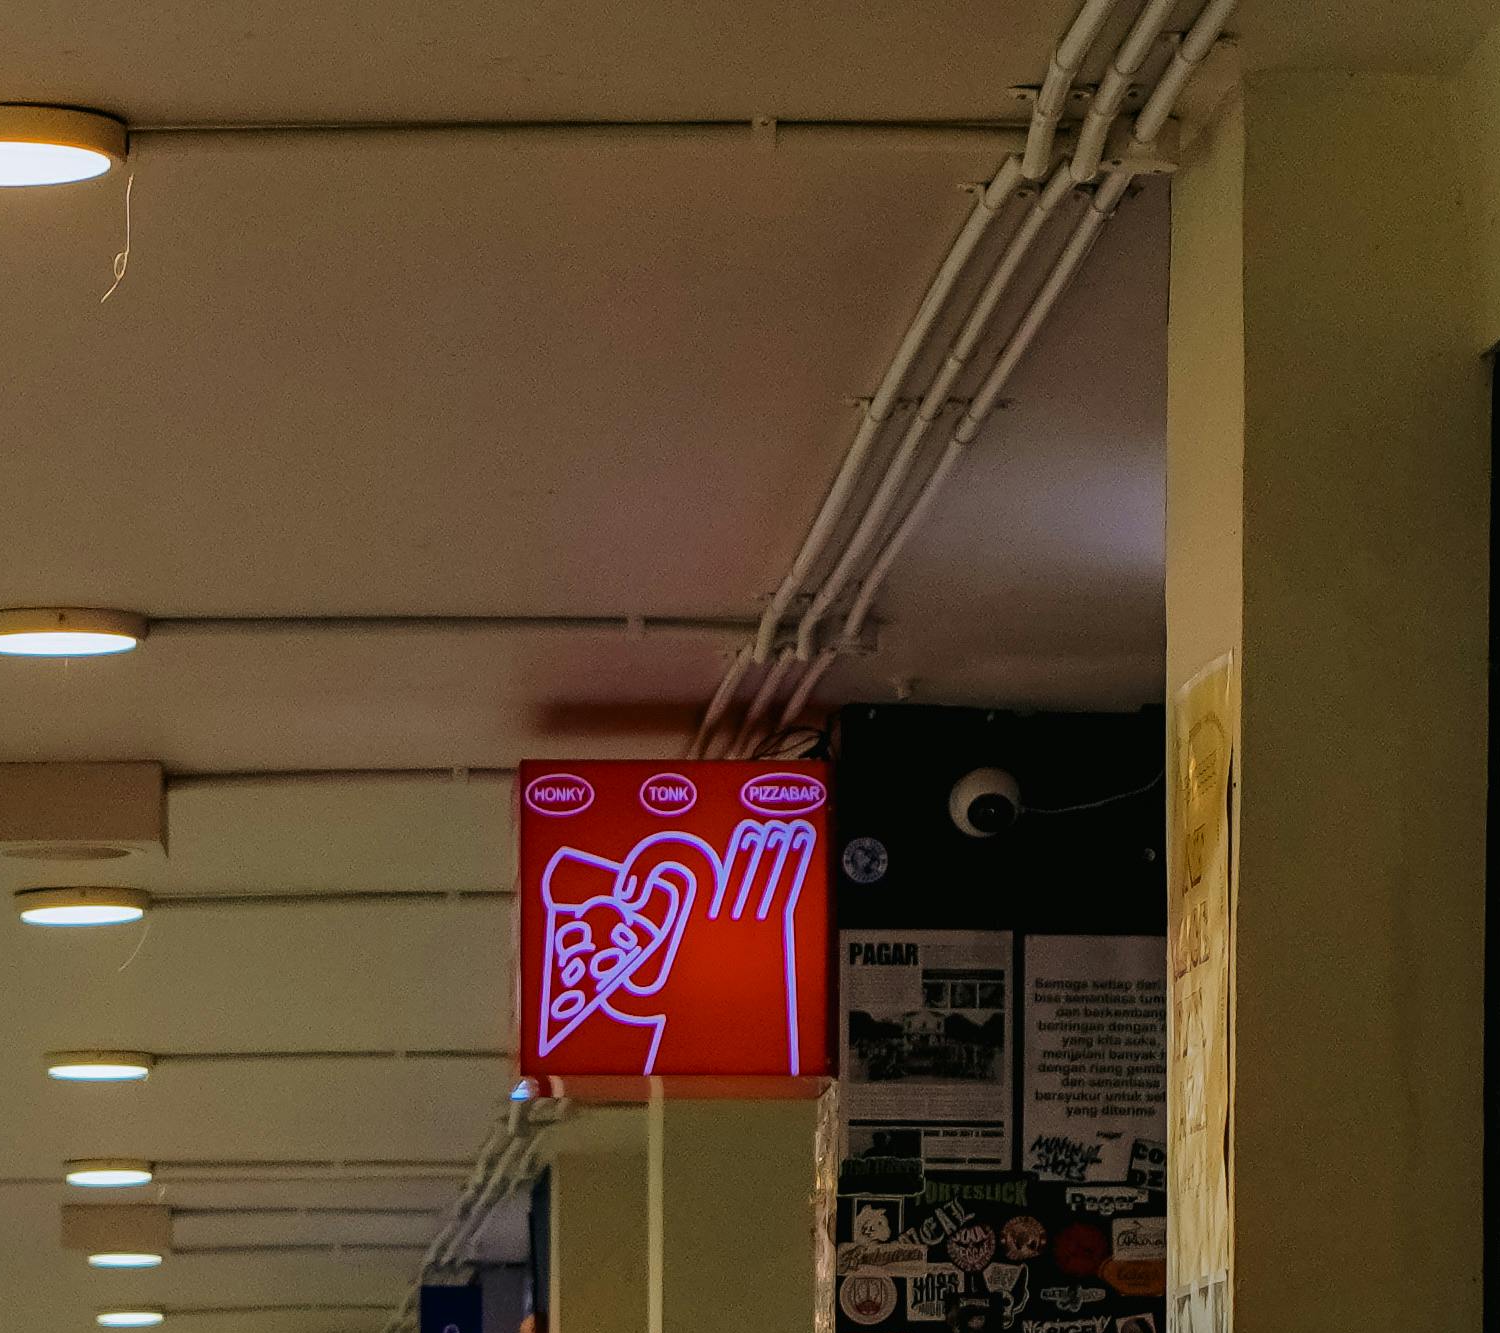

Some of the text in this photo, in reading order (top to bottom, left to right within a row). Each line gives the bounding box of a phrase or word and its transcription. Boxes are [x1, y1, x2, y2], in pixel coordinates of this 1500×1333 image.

[533, 785, 821, 802] HONKY TONK PIZZABAR
[849, 943, 918, 966] PAGAR
[1062, 1036, 1093, 1049] yang
[1061, 1077, 1084, 1088] dan
[1066, 1106, 1098, 1118] yang
